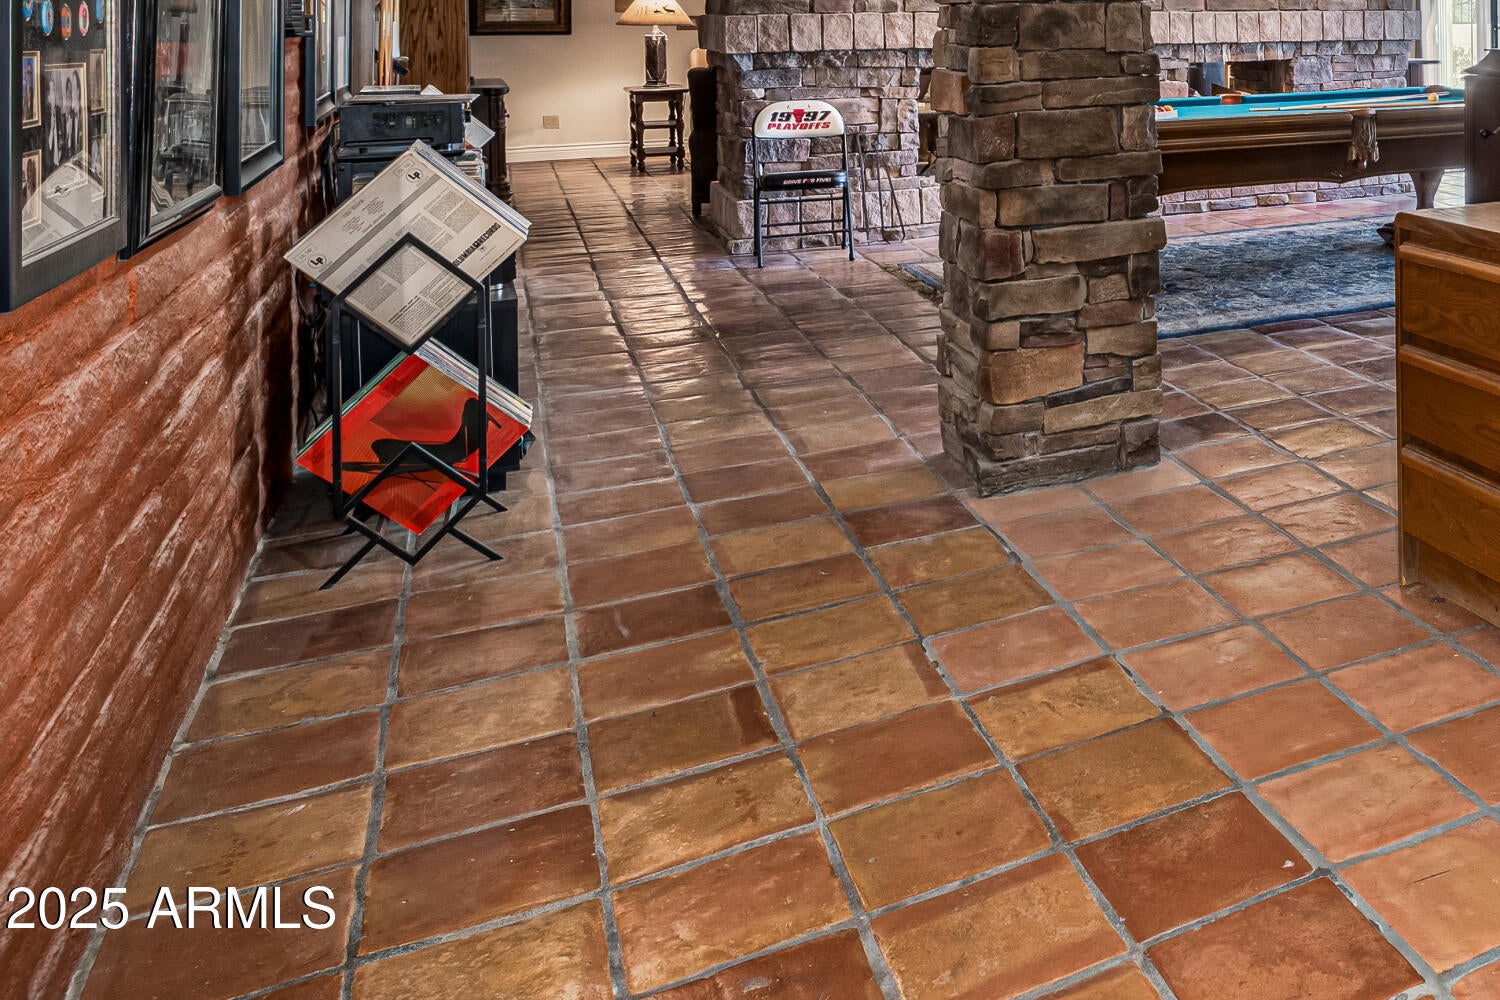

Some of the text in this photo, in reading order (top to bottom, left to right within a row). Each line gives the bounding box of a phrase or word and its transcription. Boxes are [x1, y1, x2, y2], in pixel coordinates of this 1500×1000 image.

[767, 121, 831, 130] PLAYOFFS
[452, 245, 477, 267] OLUMBIA
[477, 222, 501, 245] RECORDS
